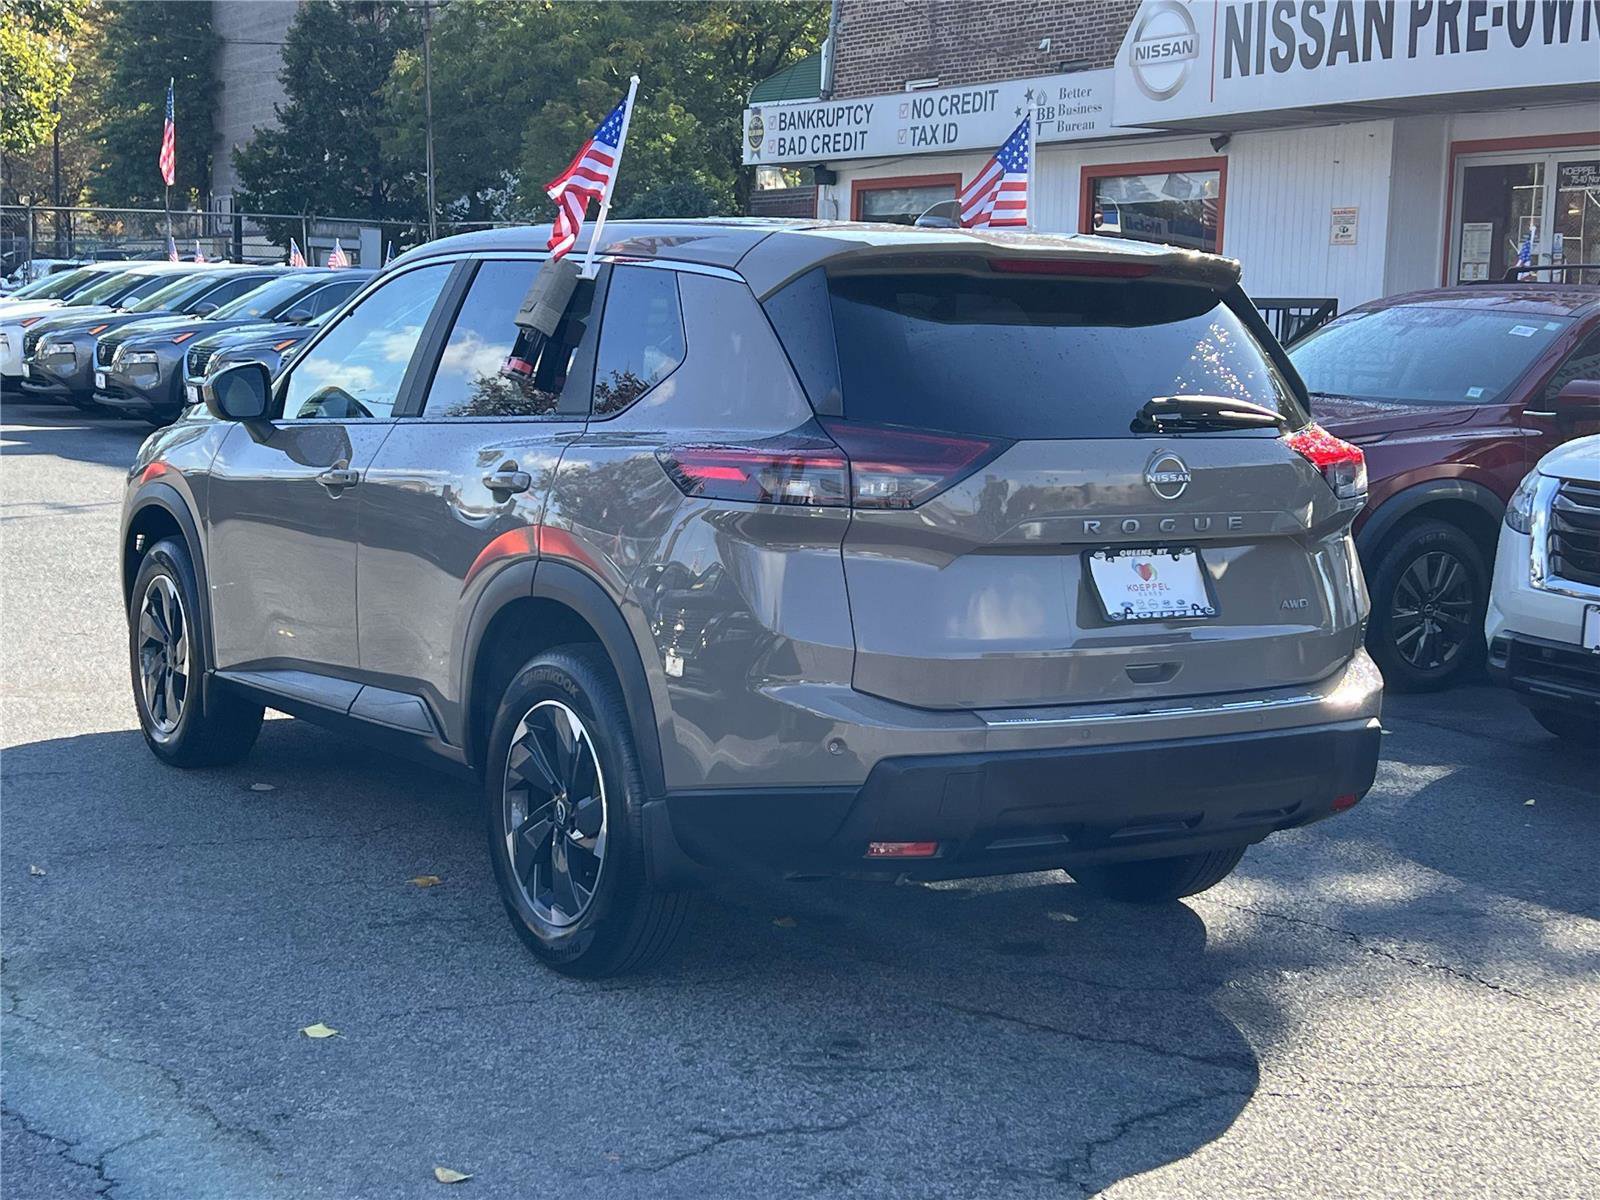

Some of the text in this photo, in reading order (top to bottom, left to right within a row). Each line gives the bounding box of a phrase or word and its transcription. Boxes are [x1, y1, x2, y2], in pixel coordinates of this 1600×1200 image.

[1223, 0, 1394, 79] NISSAN
[1134, 38, 1195, 61] NISSAN
[1059, 87, 1092, 100] Better
[911, 89, 999, 119] NO CREDIT
[1058, 102, 1103, 117] Business
[778, 103, 874, 132] BANKRUPTCY
[1057, 120, 1095, 133] Bureau
[777, 131, 868, 156] BAD CREDIT
[911, 122, 958, 147] TAX ID
[1146, 473, 1191, 482] NISSAN
[1083, 516, 1243, 535] ROGUE
[1126, 583, 1171, 592] KOEPPEL
[1281, 598, 1309, 610] AWD
